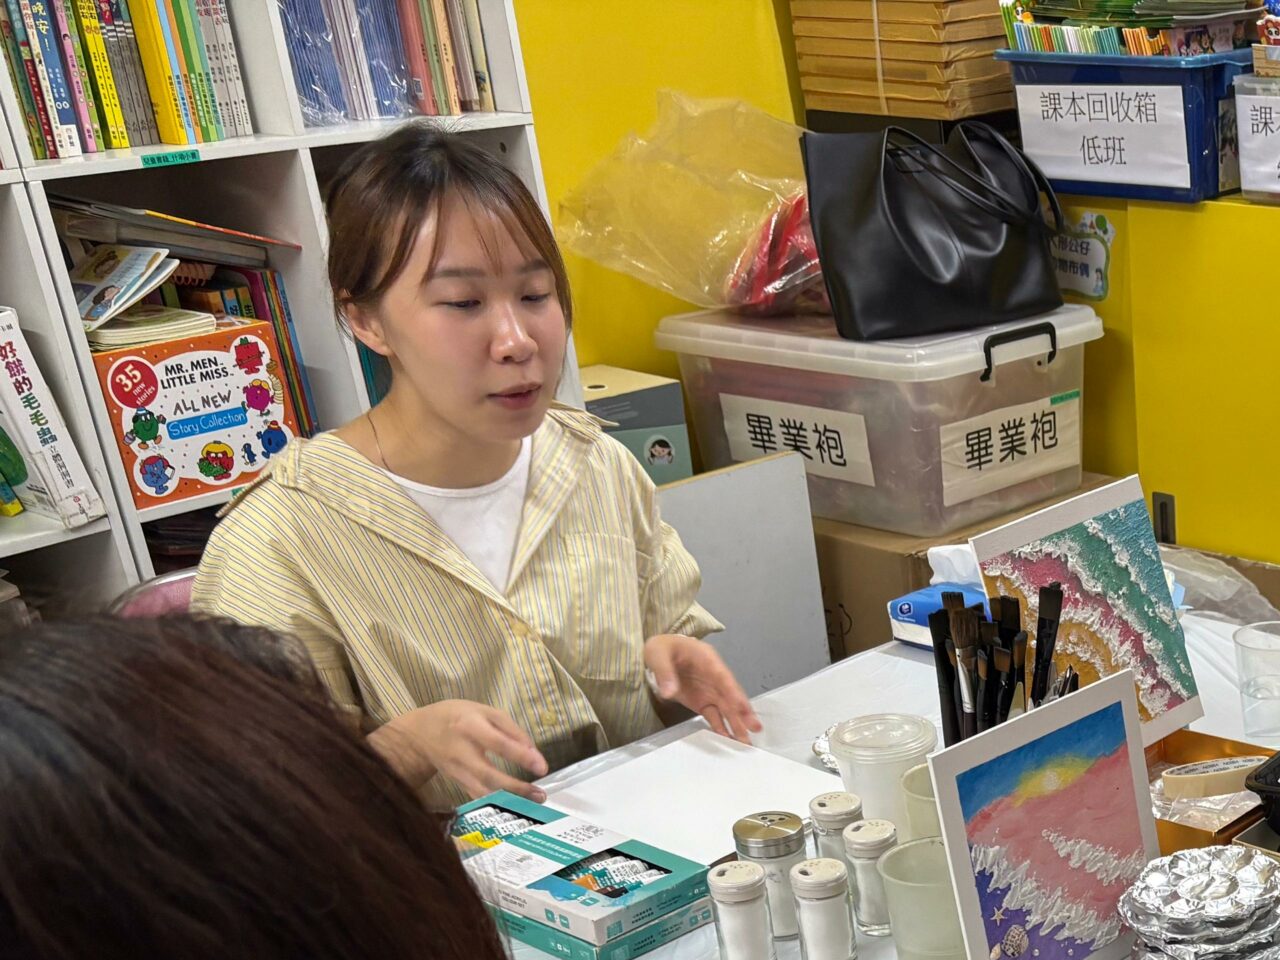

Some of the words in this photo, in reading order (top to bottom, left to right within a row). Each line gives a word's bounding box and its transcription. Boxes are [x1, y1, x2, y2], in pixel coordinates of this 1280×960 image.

[1040, 91, 1158, 124] 課本回收箱
[1080, 135, 1127, 166] 低班
[116, 364, 142, 393] 35
[133, 382, 146, 397] new
[160, 373, 197, 390] LITTLE
[200, 367, 229, 383] MISS
[0, 340, 58, 447] 好餓的毛毛蟲
[136, 385, 156, 406] stories
[173, 398, 201, 416] ALL
[202, 389, 232, 409] NEW
[169, 420, 200, 437] Story
[199, 411, 247, 431] Collection
[745, 412, 848, 467] 畢業袍
[965, 409, 1059, 472] 畢業袍
